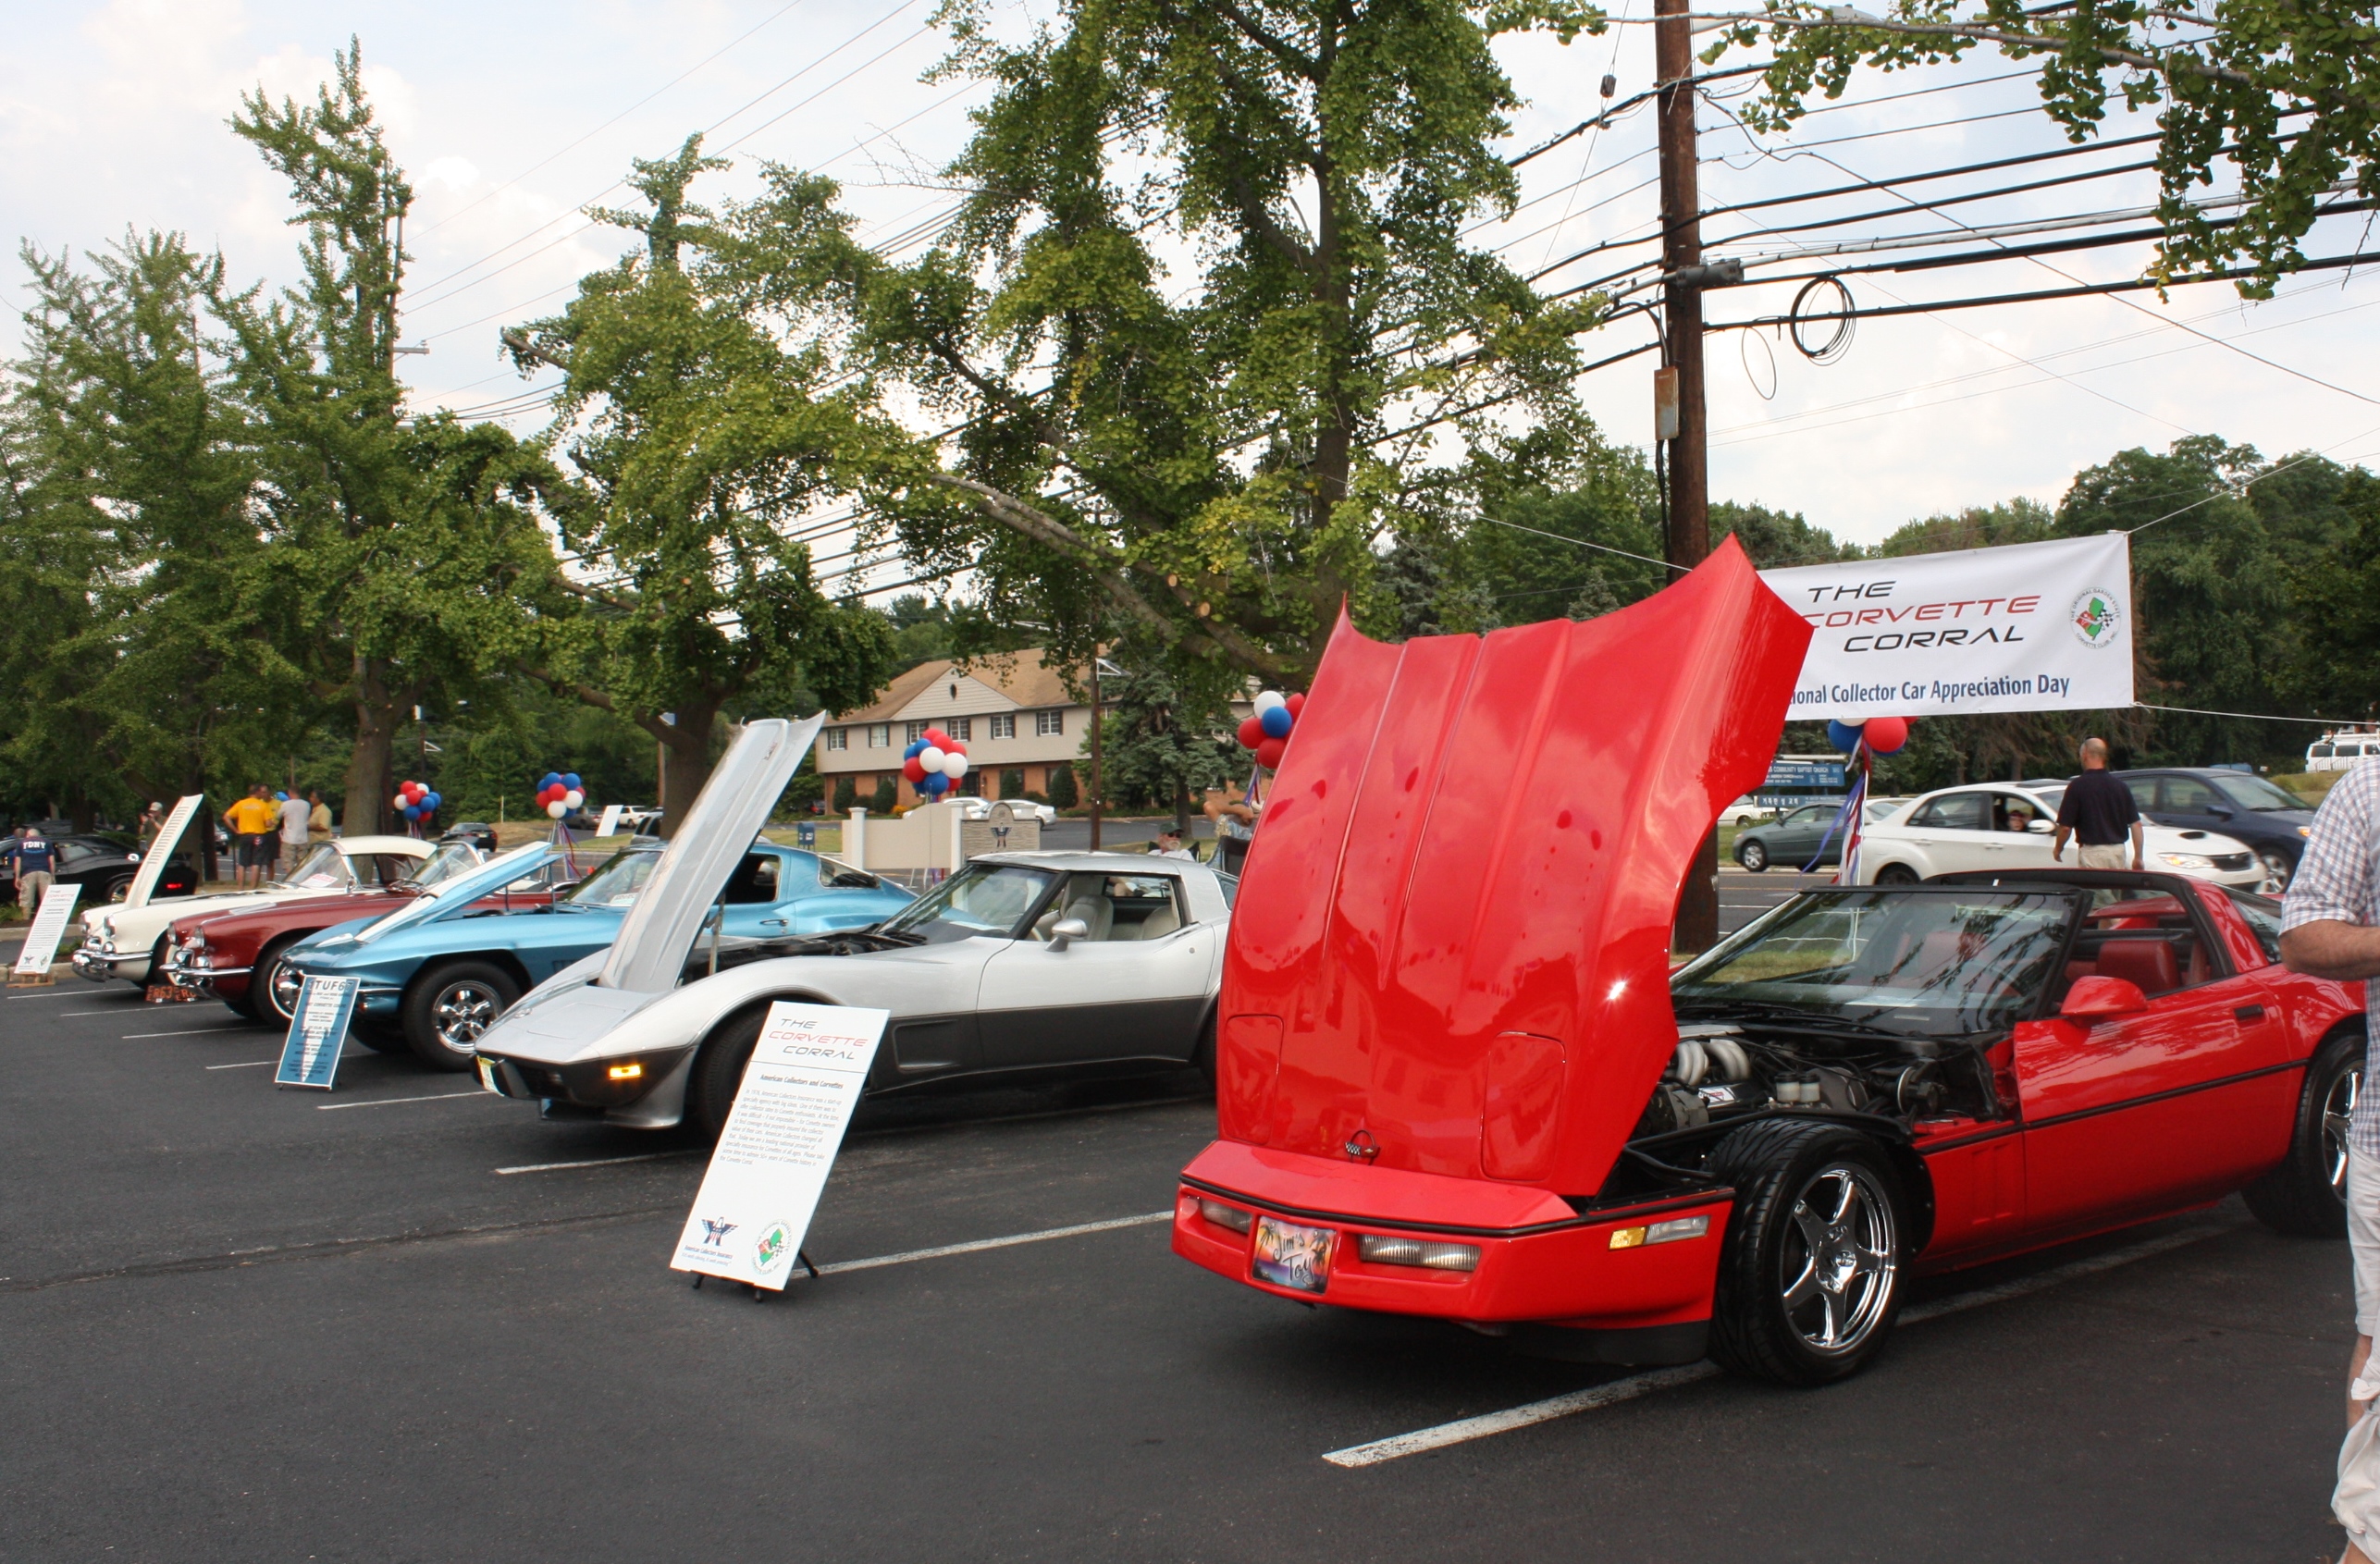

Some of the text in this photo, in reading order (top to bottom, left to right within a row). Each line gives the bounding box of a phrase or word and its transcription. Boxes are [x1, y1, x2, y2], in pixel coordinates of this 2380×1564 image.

[1808, 581, 1896, 603] THE
[1802, 595, 2041, 629] CORVETTE
[1844, 625, 2025, 653] CORRAL
[1791, 674, 2070, 705] ional Collector Car Appreciation Day
[781, 1018, 818, 1029] THE
[769, 1031, 869, 1047] CORVETTE
[783, 1046, 855, 1059] CORRAL
[760, 1074, 783, 1082] American
[784, 1076, 808, 1085] Collectors
[820, 1080, 844, 1089] Corvettes
[1273, 1229, 1305, 1263] Jim's
[1283, 1253, 1313, 1285] Toy
